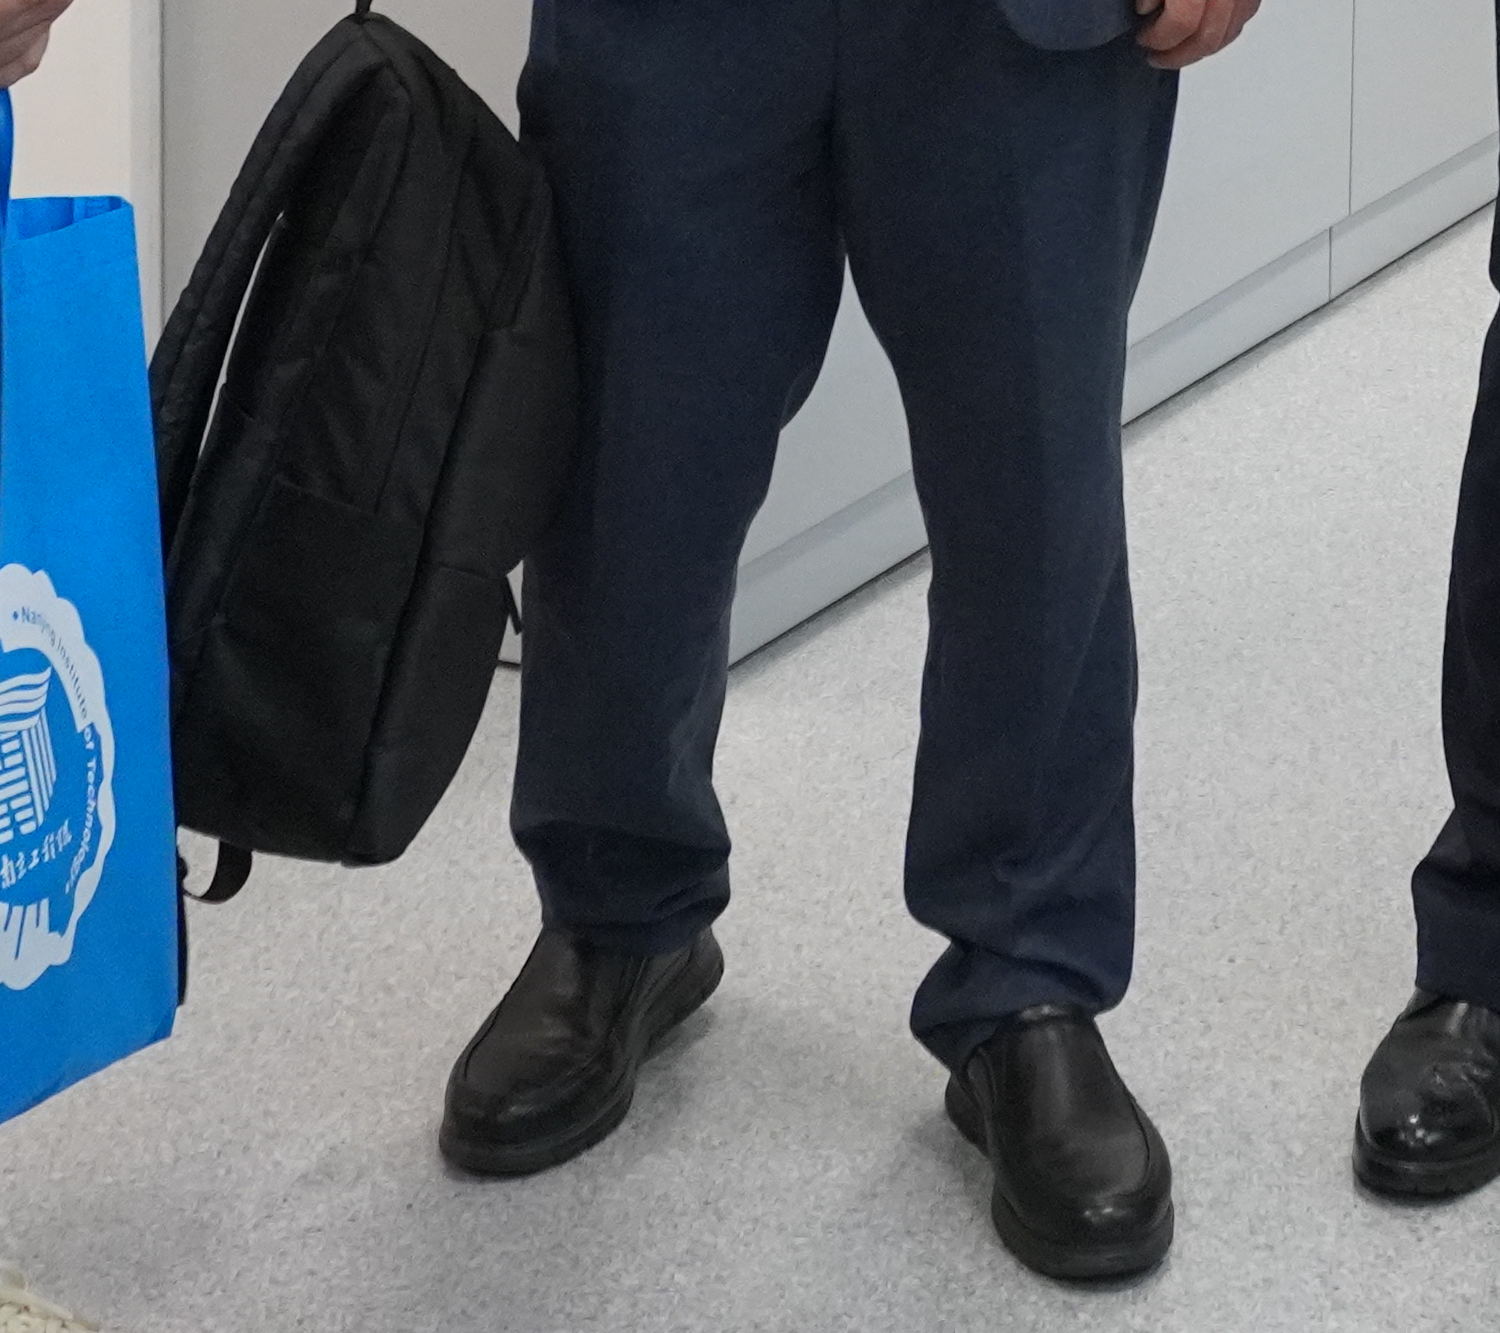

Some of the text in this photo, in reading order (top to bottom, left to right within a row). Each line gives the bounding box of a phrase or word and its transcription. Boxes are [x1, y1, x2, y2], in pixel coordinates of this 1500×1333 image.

[57, 638, 88, 720] Institute
[84, 727, 96, 750] of
[70, 756, 97, 889] Technology
